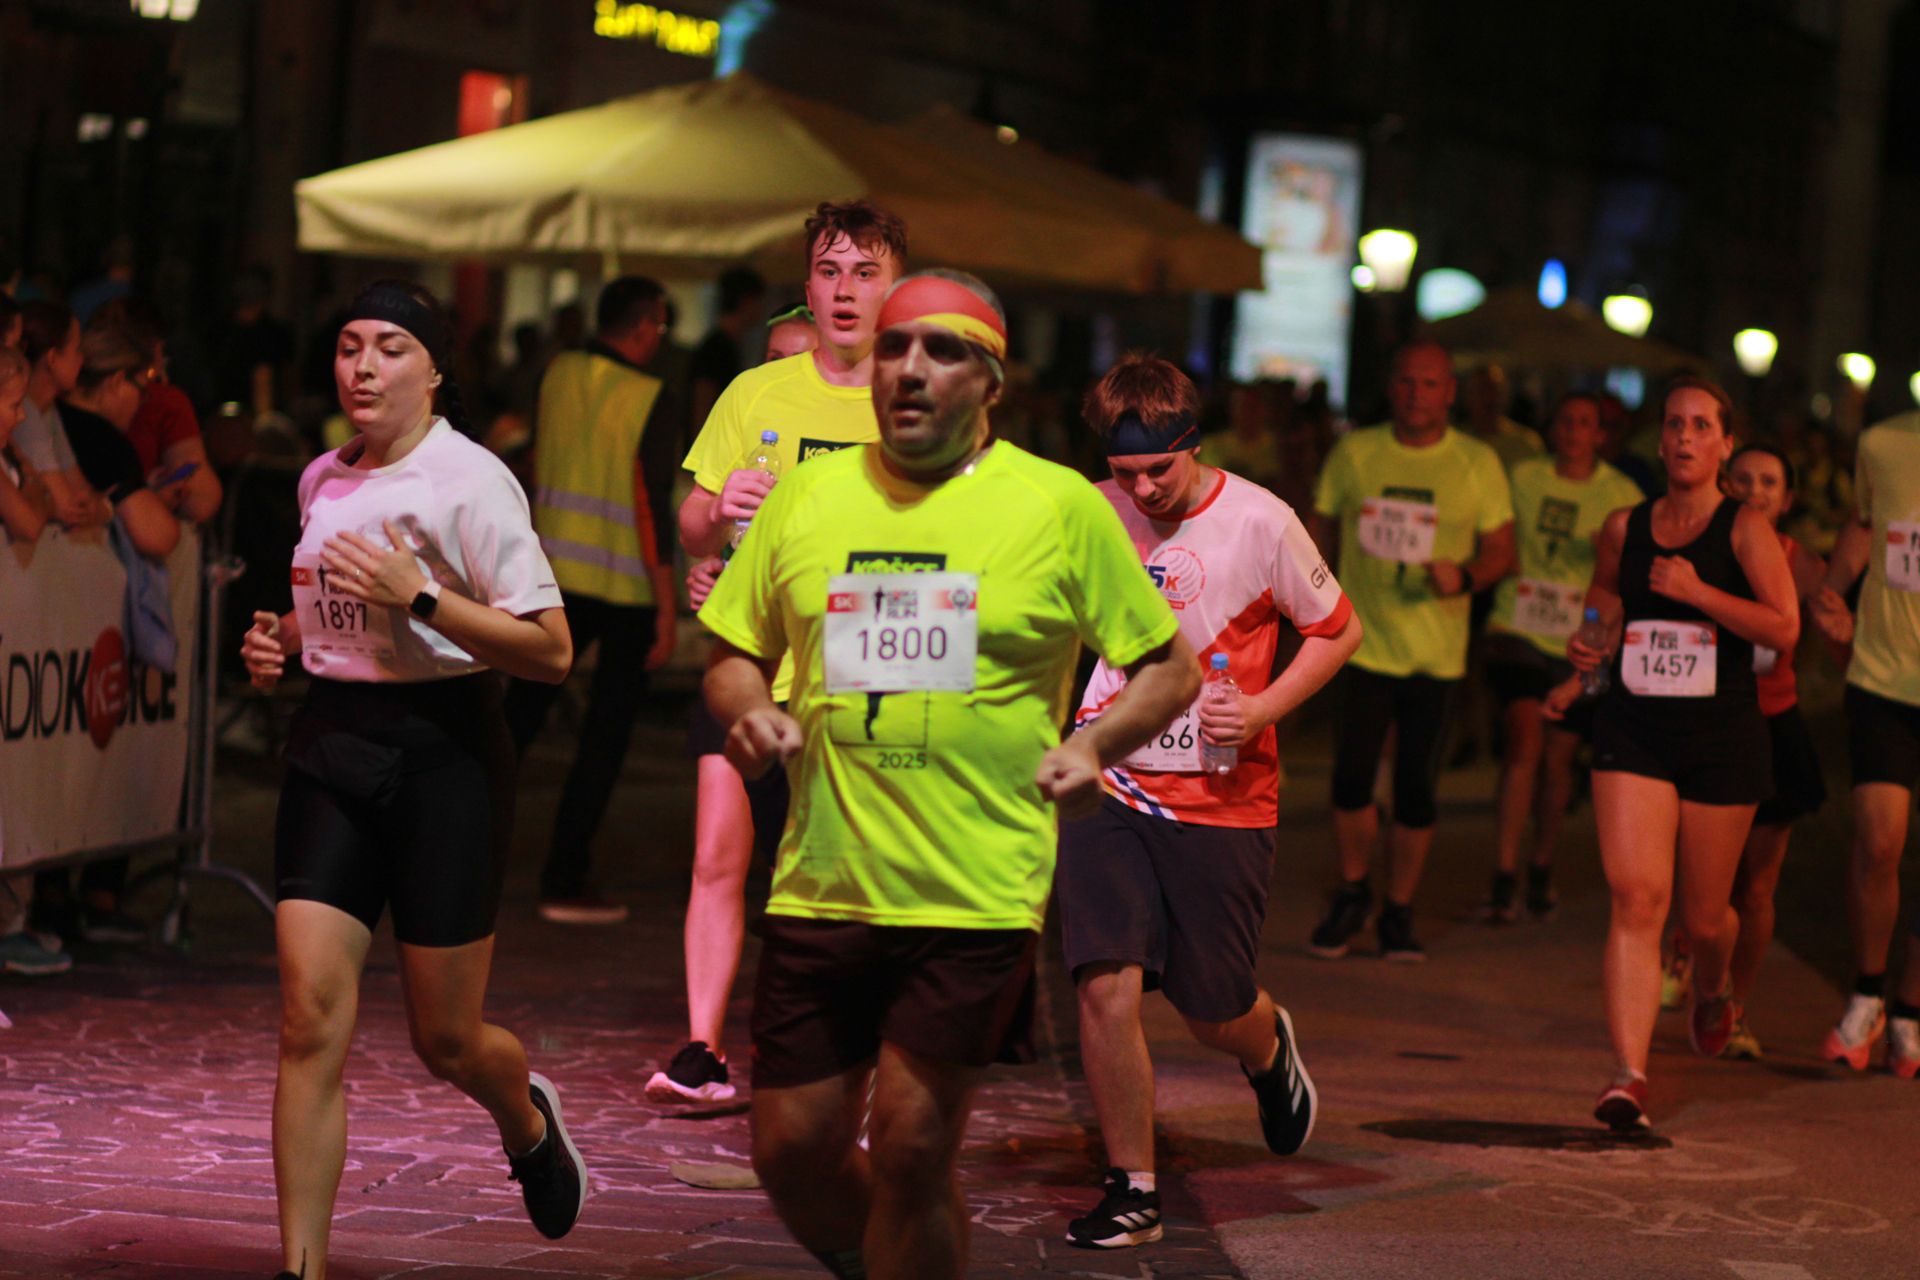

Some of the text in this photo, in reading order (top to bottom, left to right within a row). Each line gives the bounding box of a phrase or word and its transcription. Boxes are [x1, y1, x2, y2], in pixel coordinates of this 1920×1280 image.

[314, 600, 367, 632] 1897
[857, 626, 947, 661] 1800
[1641, 653, 1698, 677] 1457
[877, 751, 927, 769] 2025
